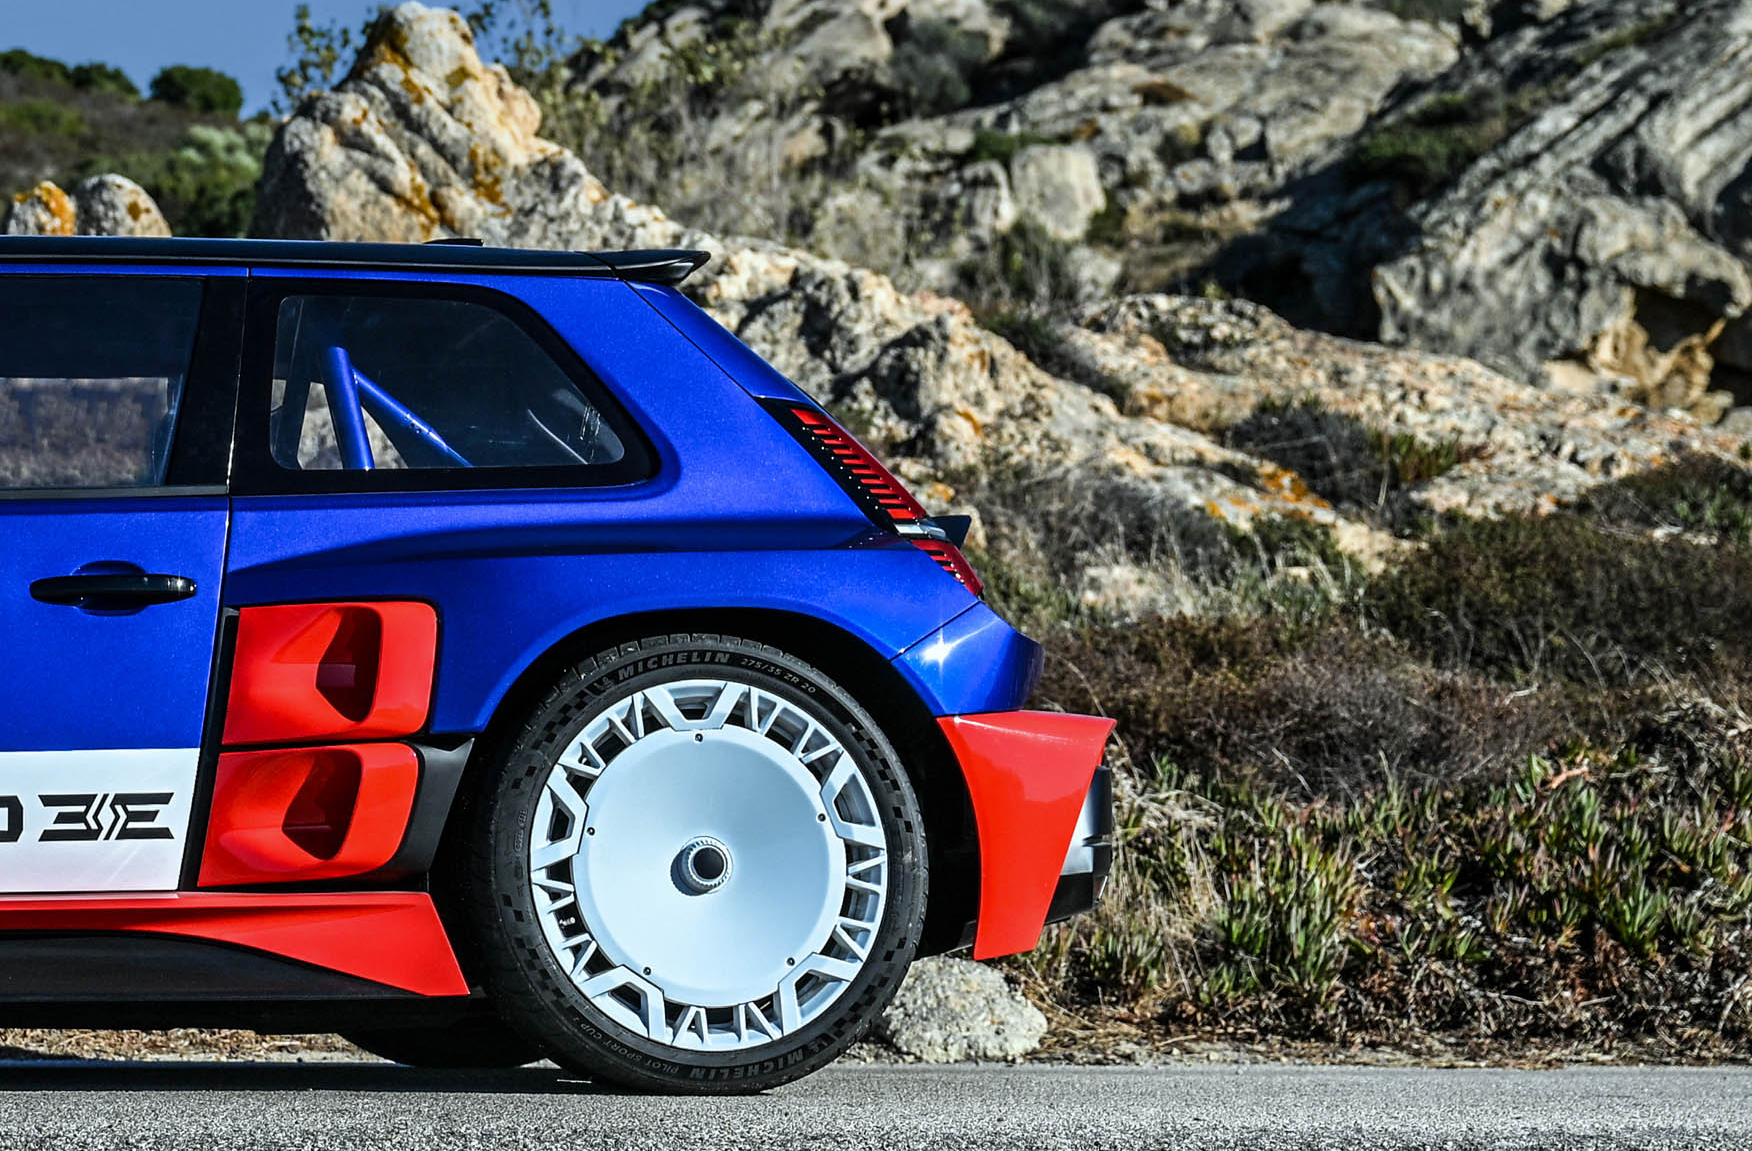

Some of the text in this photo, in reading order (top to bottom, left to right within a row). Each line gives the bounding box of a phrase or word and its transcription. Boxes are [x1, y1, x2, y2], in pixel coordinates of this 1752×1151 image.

[618, 651, 816, 694] MICHELIN 275/35 ZR 20
[580, 1023, 603, 1040] CUP
[603, 1040, 643, 1062] SPORT
[646, 1059, 680, 1074] PILOT
[689, 1048, 804, 1080] MICHELIN
